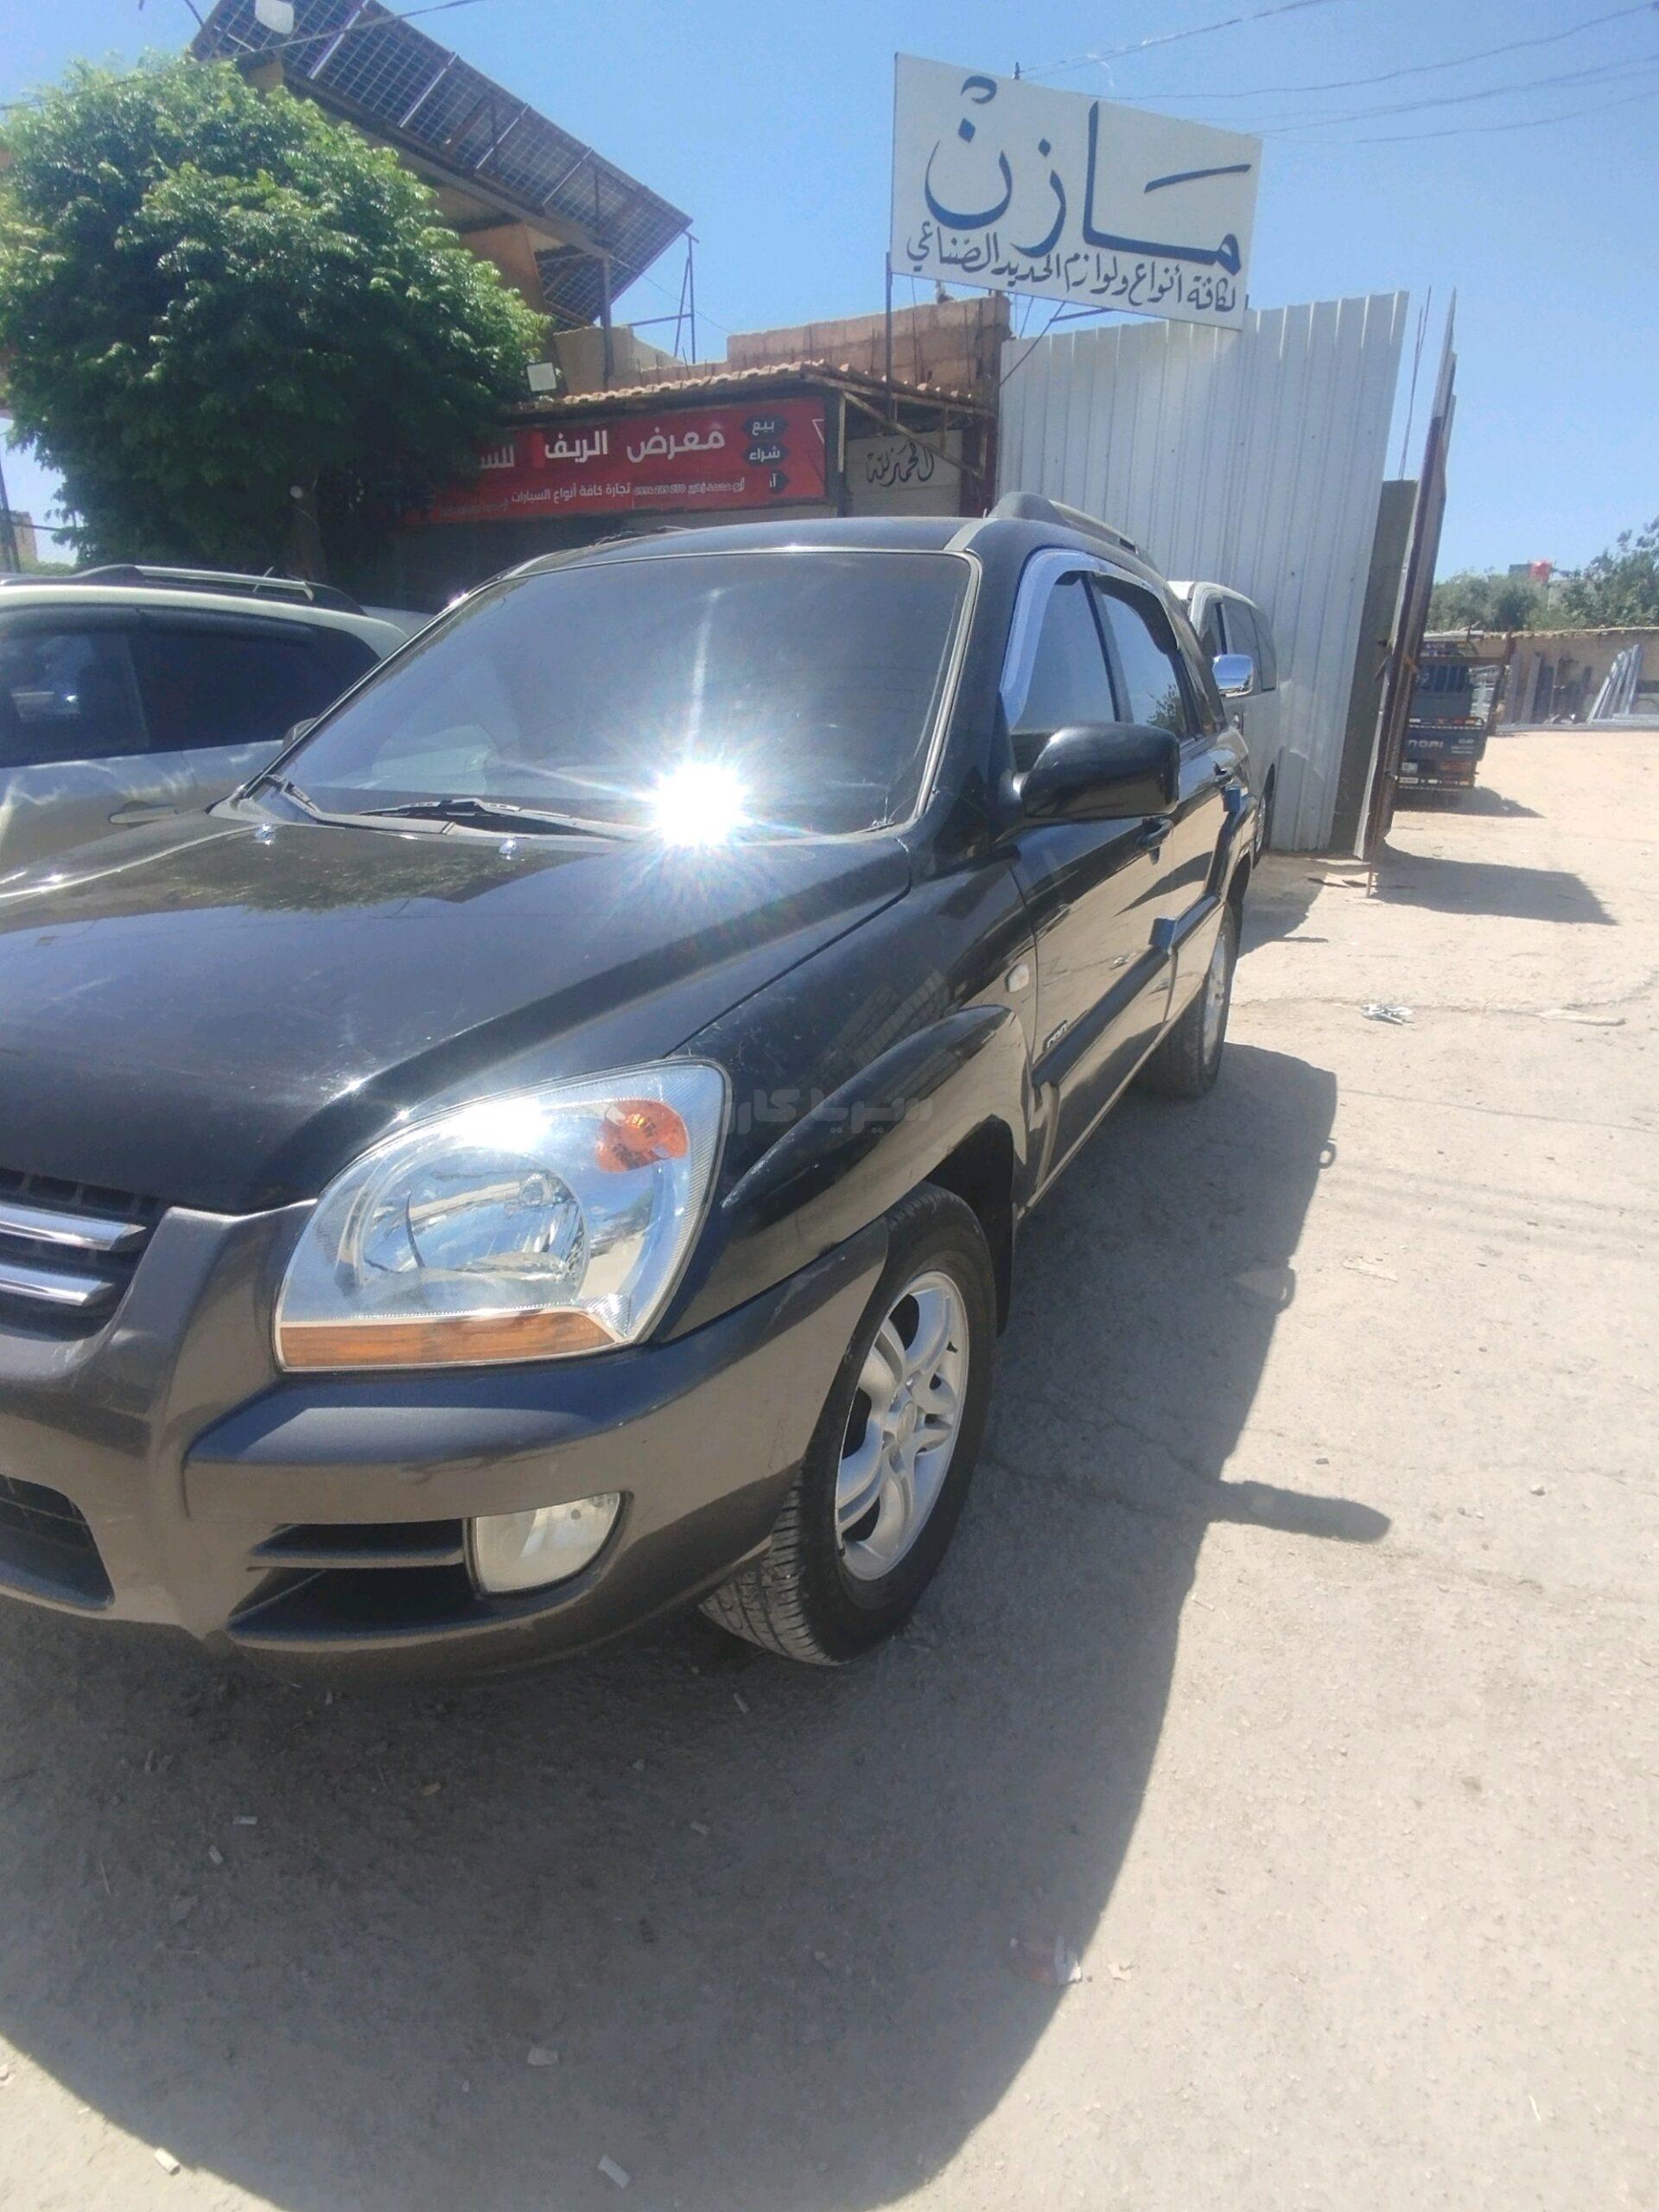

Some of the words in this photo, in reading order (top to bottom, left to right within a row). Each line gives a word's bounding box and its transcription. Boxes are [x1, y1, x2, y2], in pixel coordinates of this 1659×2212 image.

[925, 75, 1251, 275] مازن
[991, 253, 1061, 287] الحديد
[1065, 251, 1128, 296] ولوازم
[1128, 260, 1183, 306] أنواع
[1187, 276, 1236, 313] لكافة
[626, 425, 725, 463] معرض
[752, 421, 775, 436] بيع
[544, 429, 608, 463] الريف
[749, 445, 780, 464] شراء
[512, 487, 550, 505] السيارات
[553, 482, 576, 504] أنواع
[580, 484, 603, 497] كافة
[606, 482, 631, 498] تجارة
